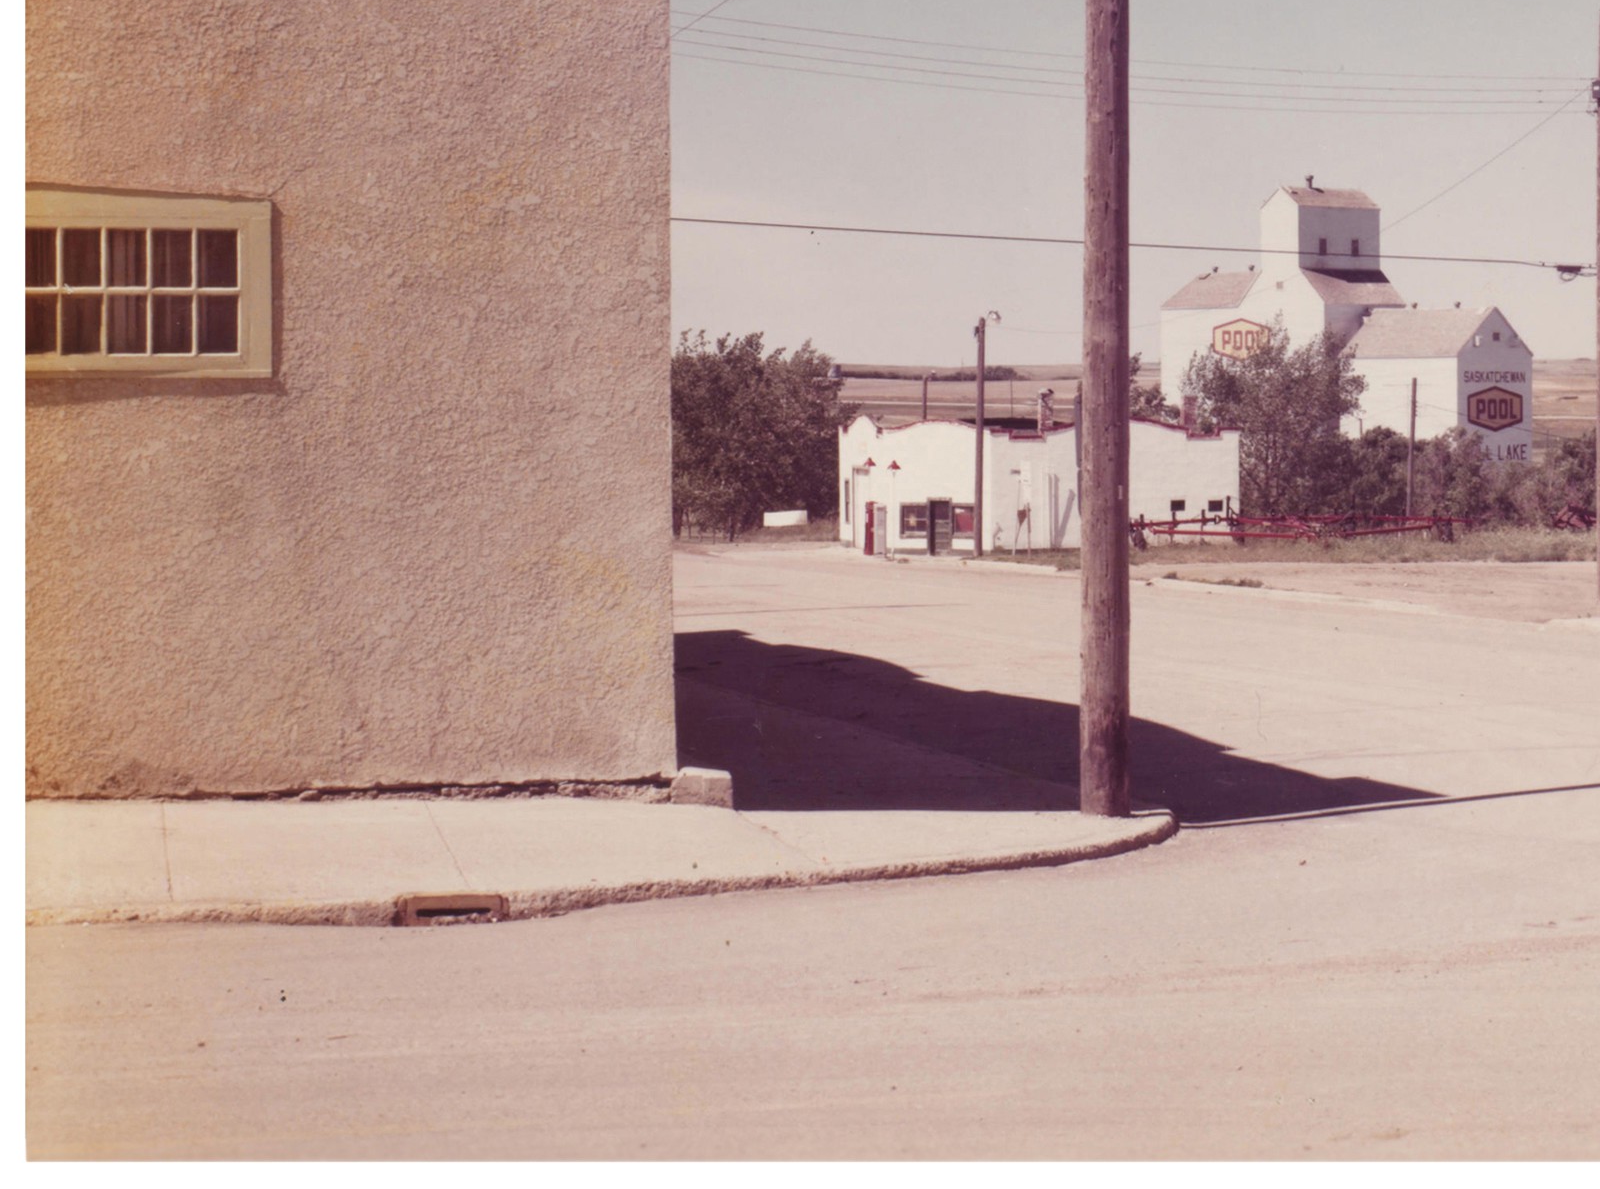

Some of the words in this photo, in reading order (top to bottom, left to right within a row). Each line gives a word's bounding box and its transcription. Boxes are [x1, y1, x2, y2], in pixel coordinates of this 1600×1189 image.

[1463, 371, 1526, 384] SASKATCHEWAN
[1476, 398, 1517, 419] POOL
[1498, 443, 1527, 461] LAKE
